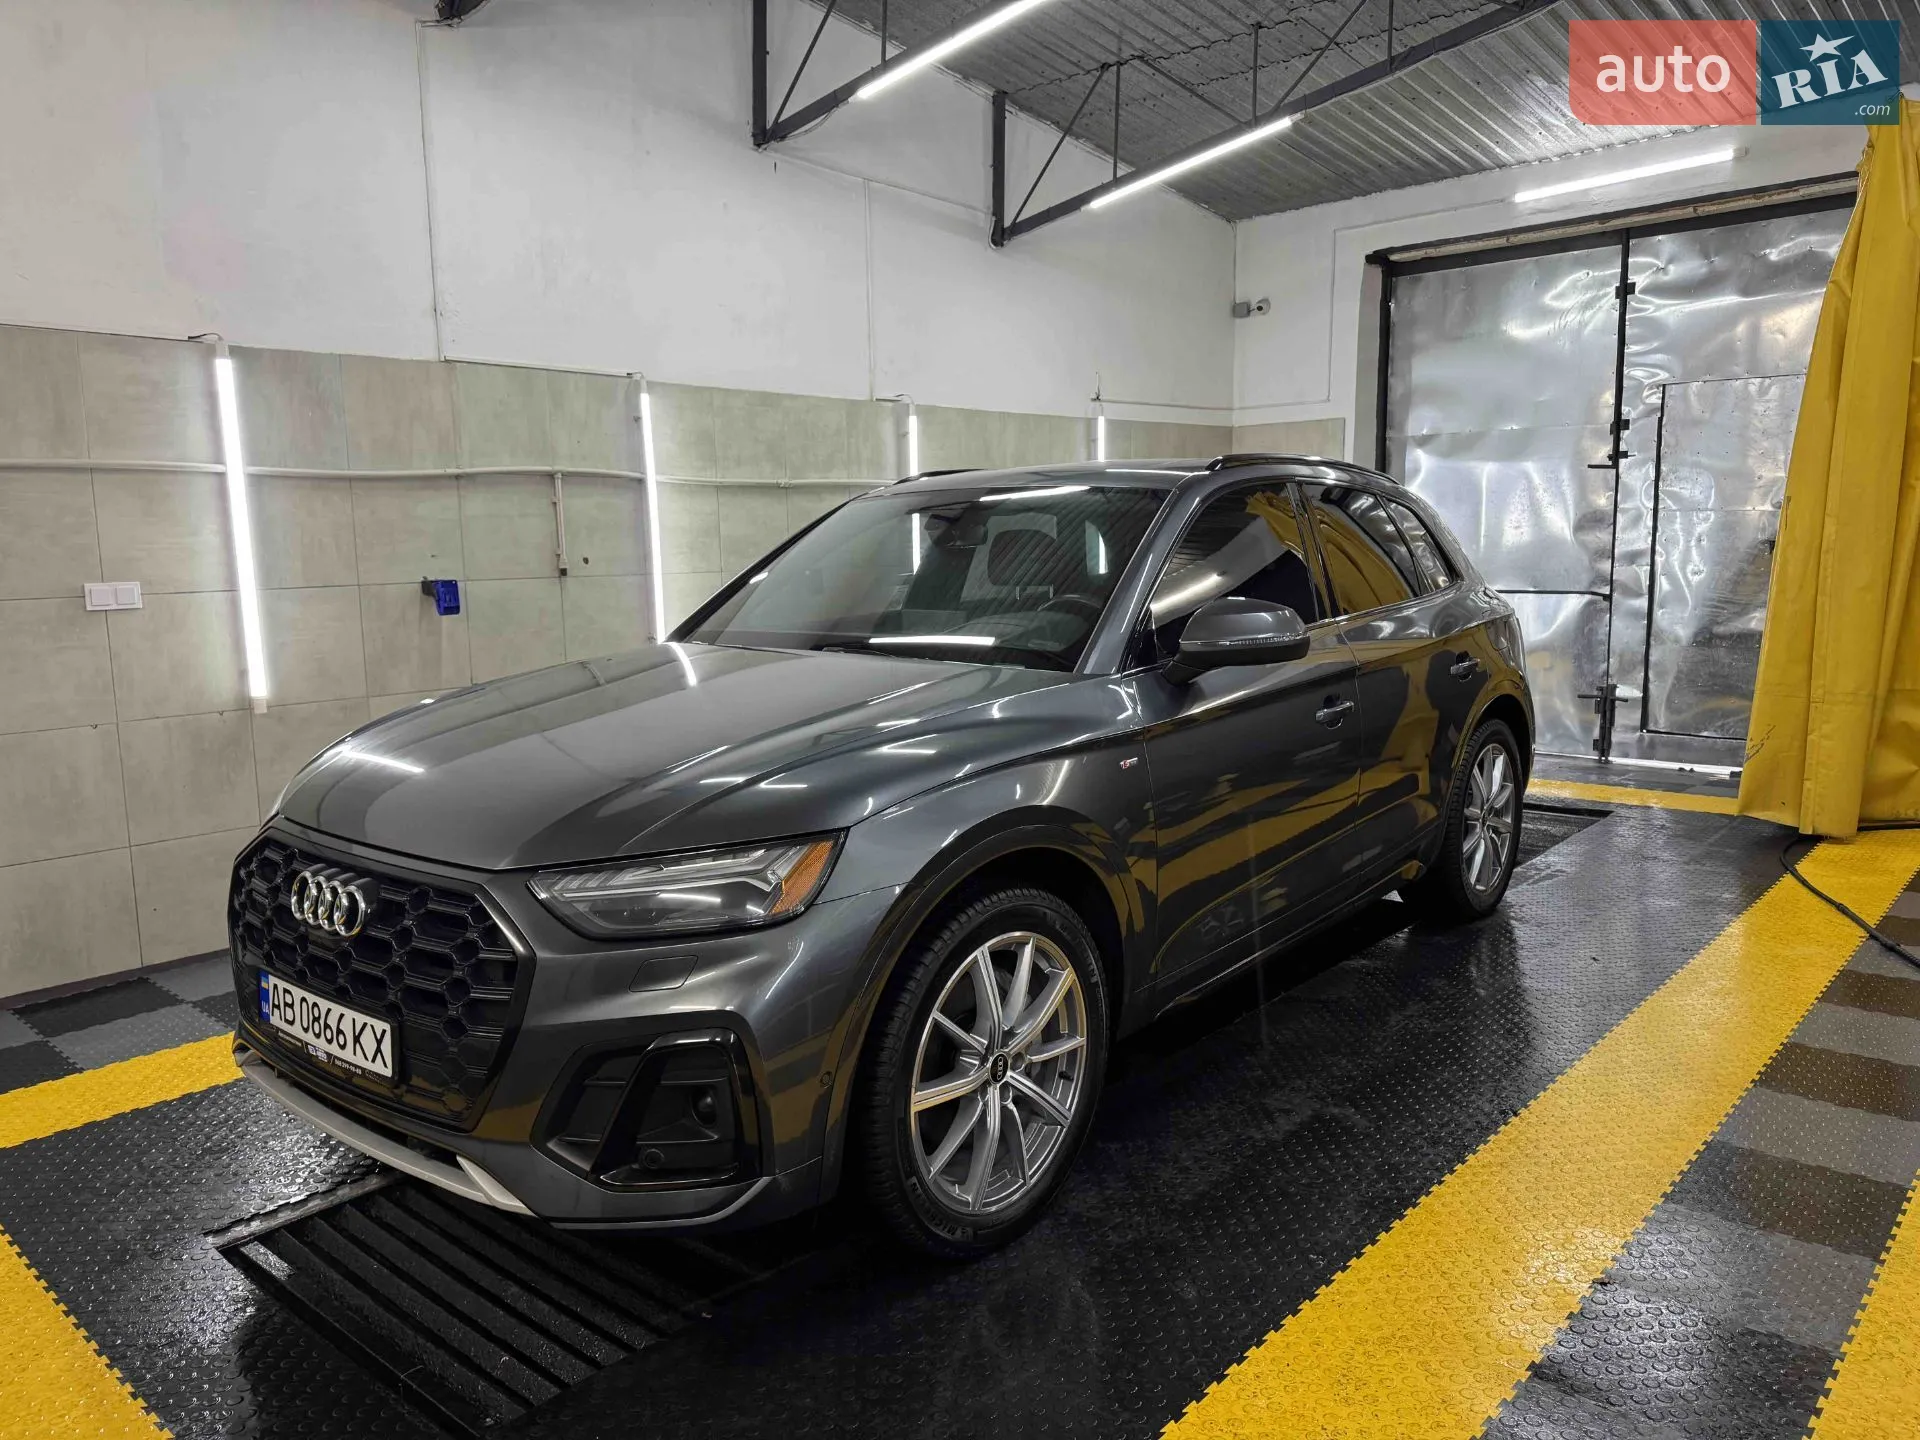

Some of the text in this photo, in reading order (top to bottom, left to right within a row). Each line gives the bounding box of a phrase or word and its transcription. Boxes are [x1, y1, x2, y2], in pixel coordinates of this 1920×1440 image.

[261, 1001, 270, 1015] UA
[271, 983, 389, 1070] AB 0866 KX
